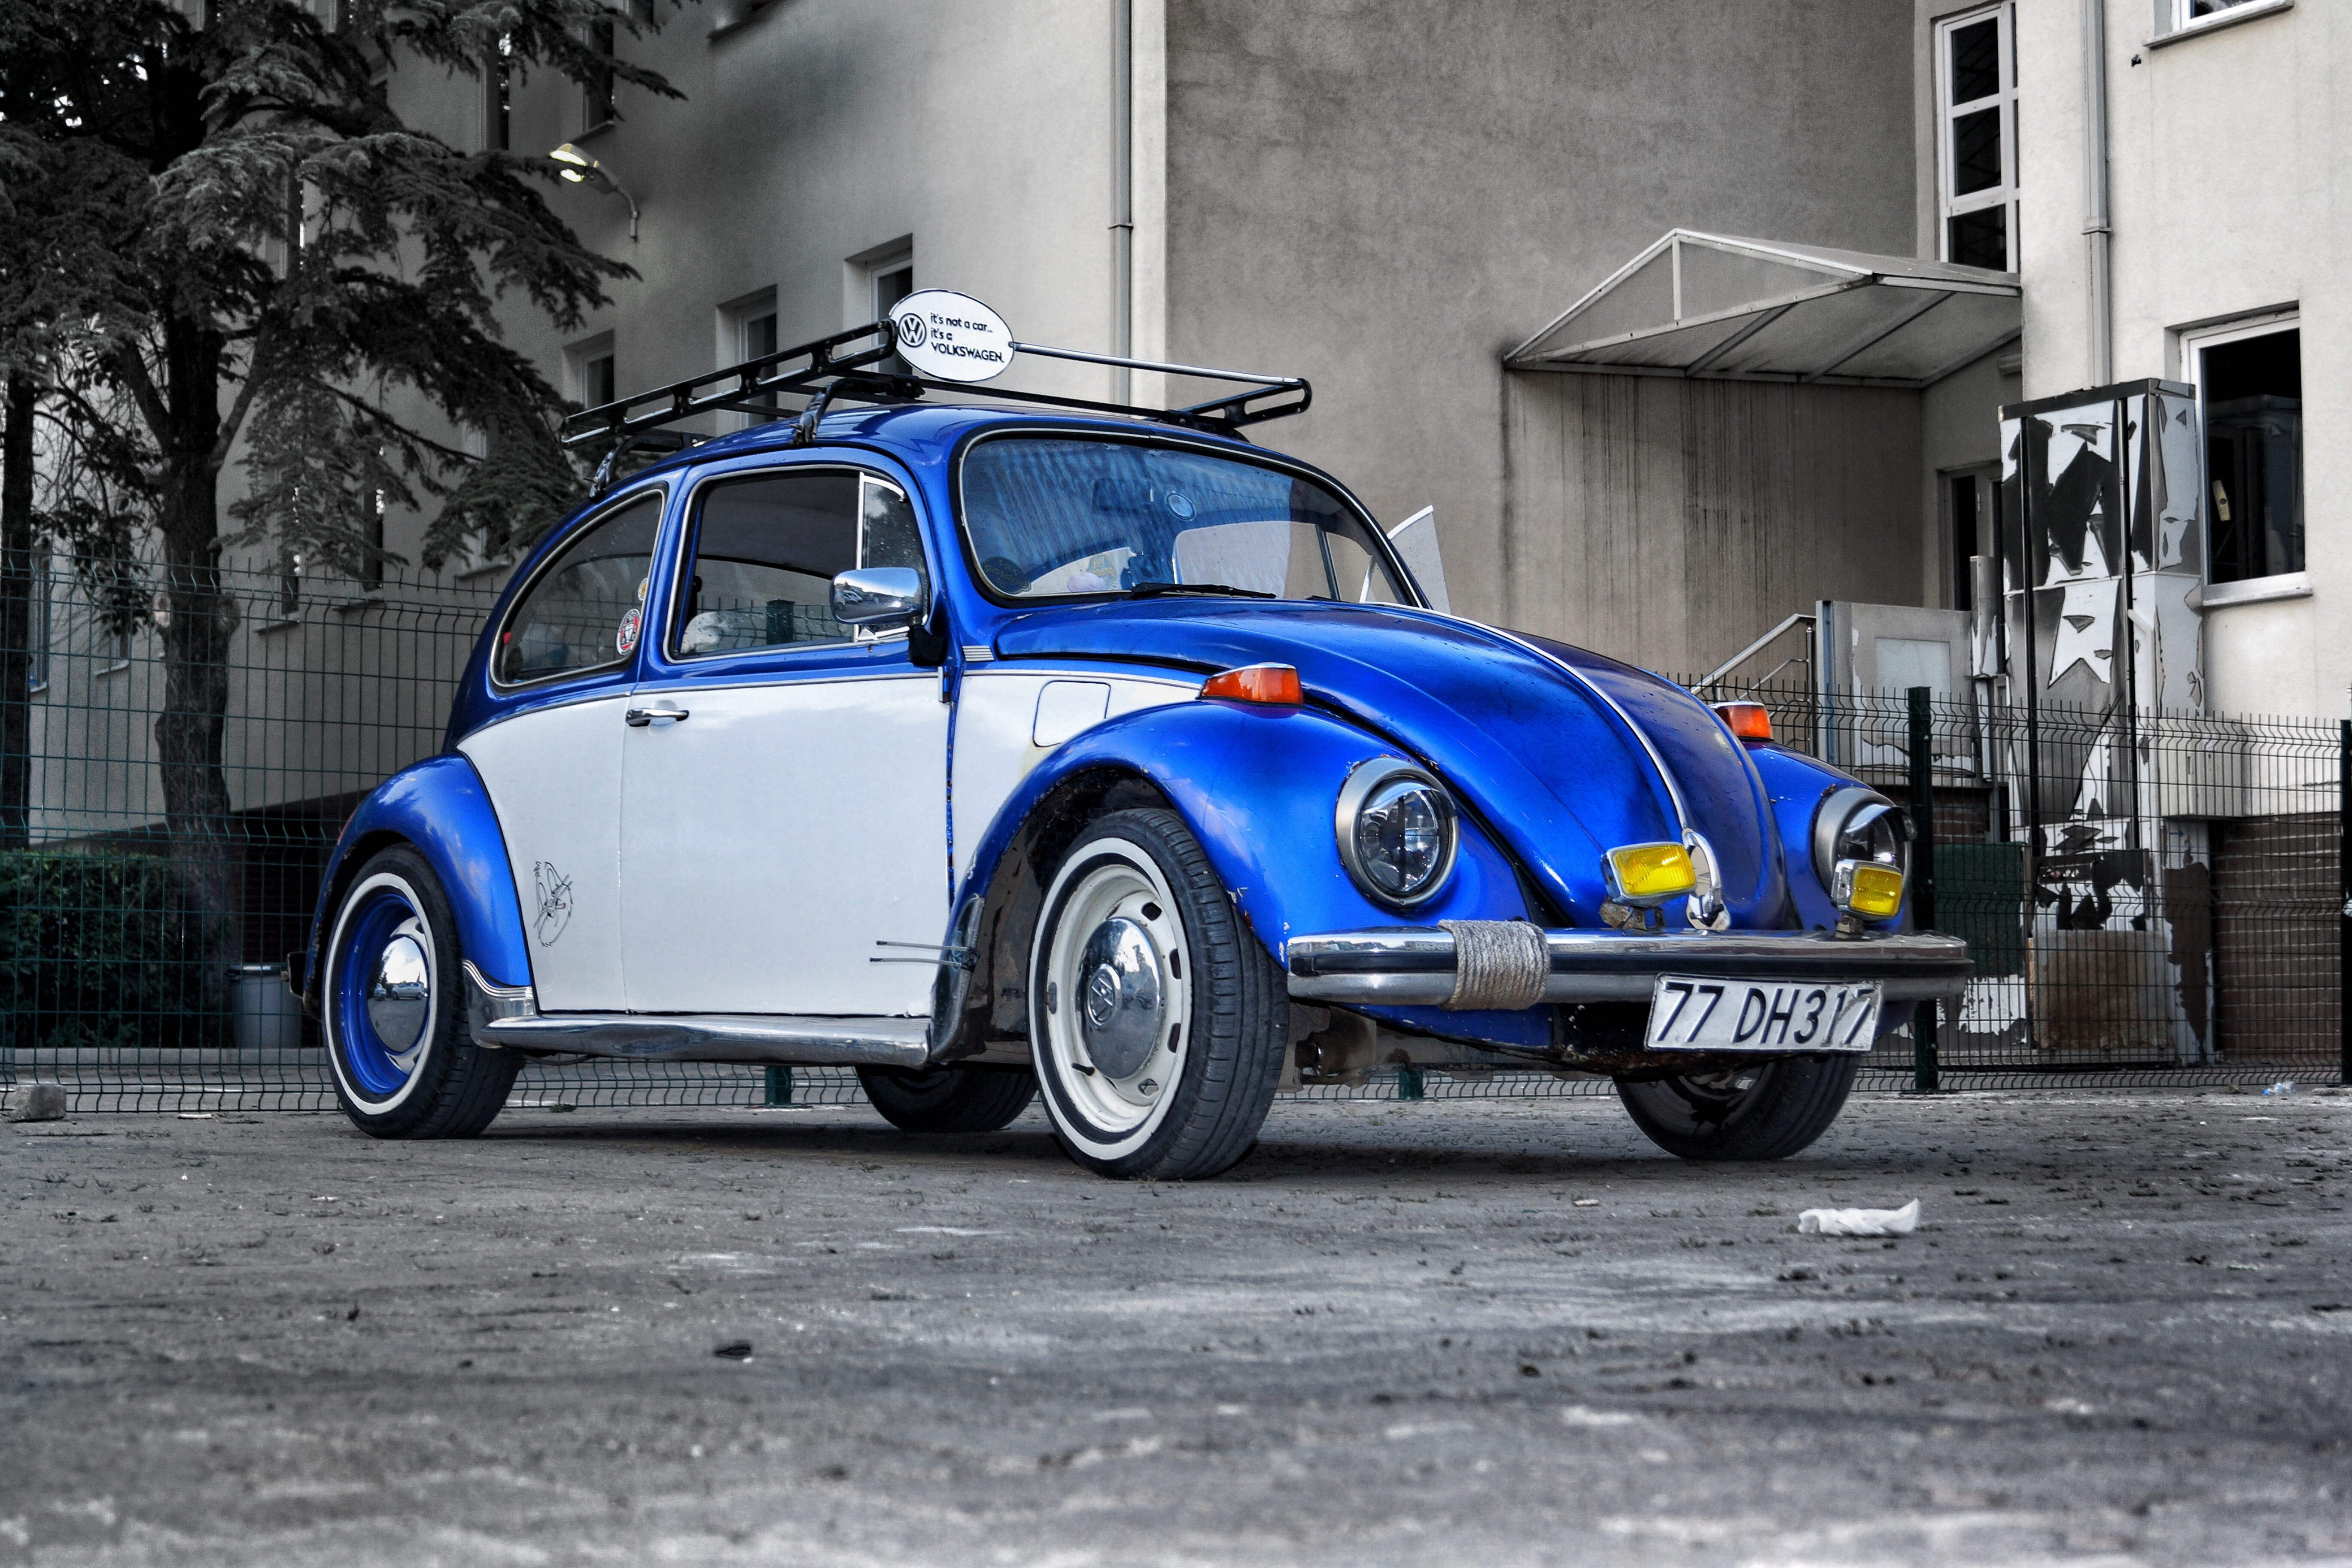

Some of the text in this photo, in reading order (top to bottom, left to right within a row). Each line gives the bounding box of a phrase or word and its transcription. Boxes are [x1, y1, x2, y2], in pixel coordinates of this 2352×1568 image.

[930, 312, 943, 324] it's
[946, 318, 962, 327] not
[964, 321, 970, 329] a
[931, 326, 952, 341] it's a
[1655, 981, 1725, 1042] 77
